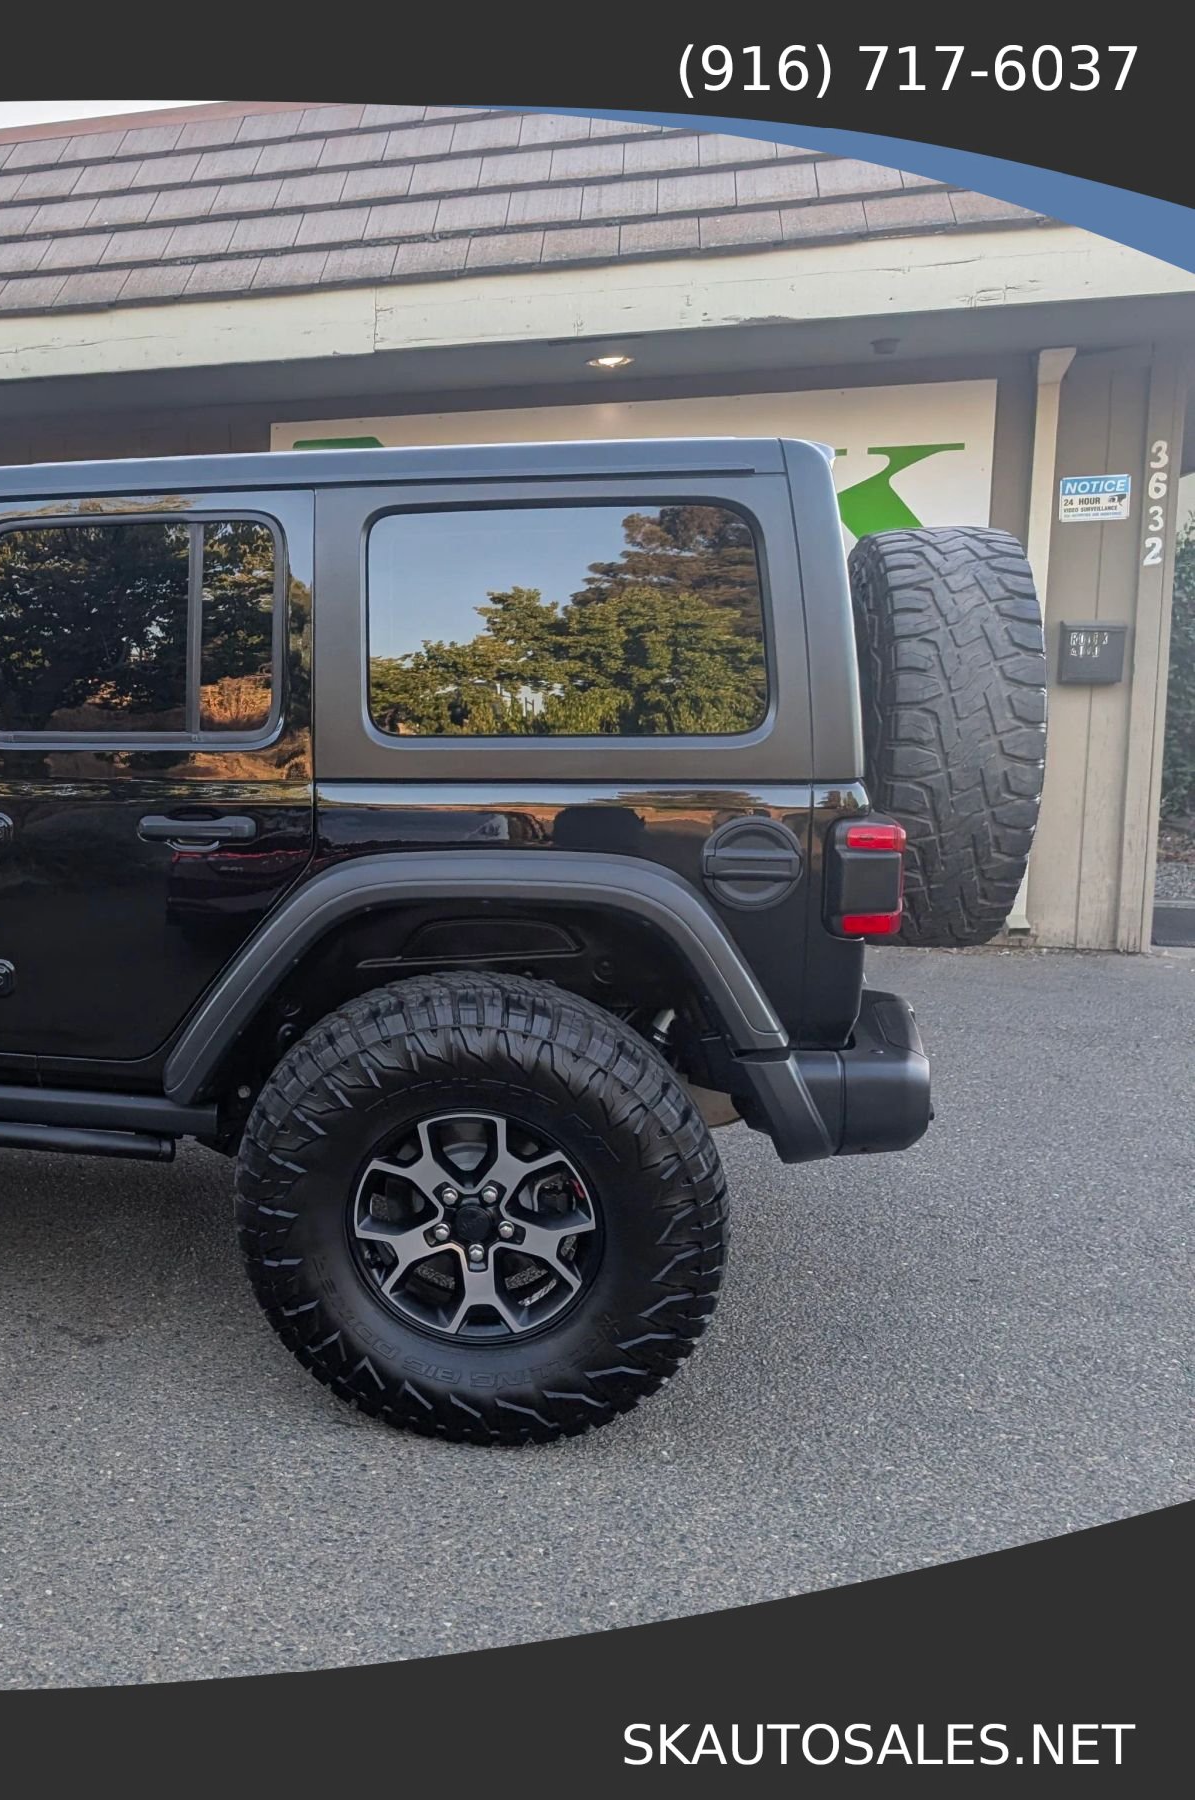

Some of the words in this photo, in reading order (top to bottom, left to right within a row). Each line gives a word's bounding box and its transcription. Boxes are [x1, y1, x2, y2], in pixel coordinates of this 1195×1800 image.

[1064, 479, 1127, 495] NOTICE
[1063, 498, 1074, 507] 24
[1078, 496, 1101, 506] HOUR
[1142, 439, 1170, 567] 3632
